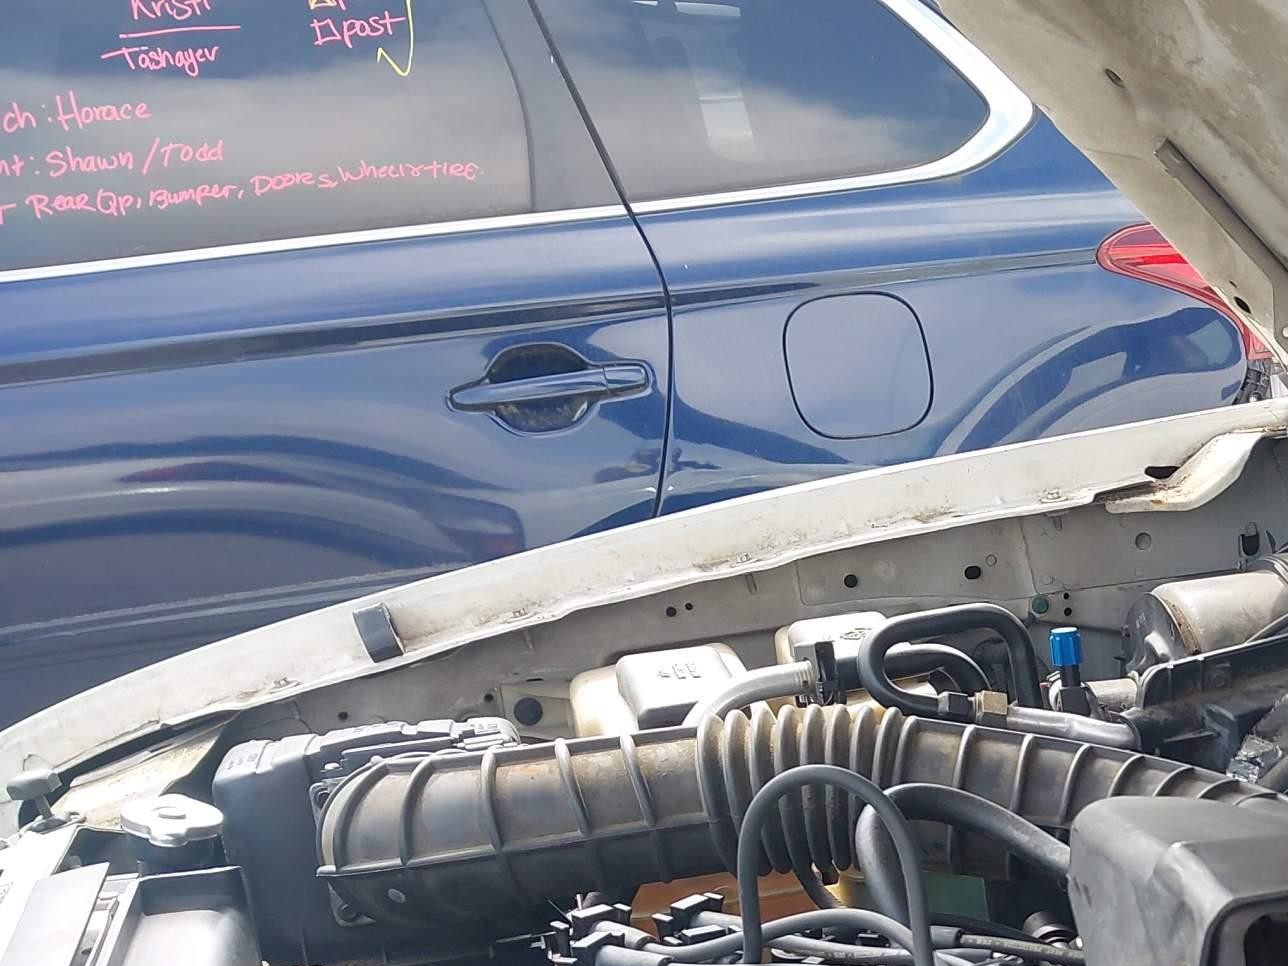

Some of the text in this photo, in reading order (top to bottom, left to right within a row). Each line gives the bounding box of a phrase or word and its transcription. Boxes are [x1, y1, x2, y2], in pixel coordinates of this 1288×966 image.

[342, 10, 406, 48] post
[55, 90, 152, 130] Horace
[45, 146, 134, 178] Shawn
